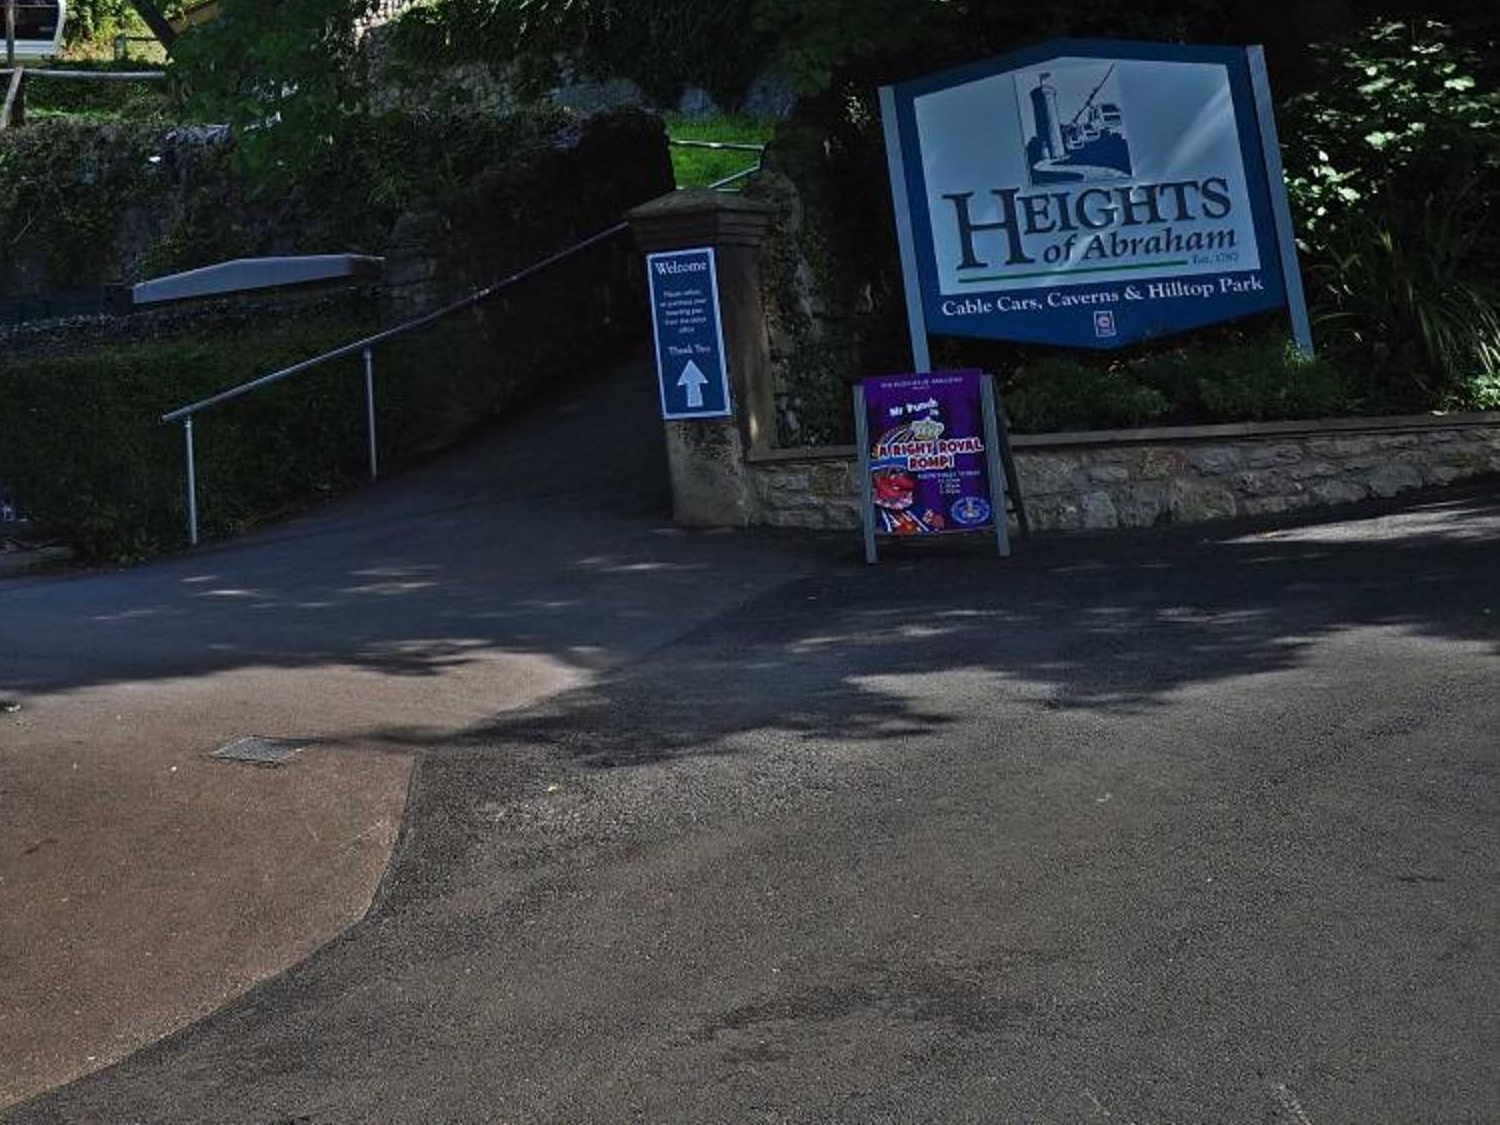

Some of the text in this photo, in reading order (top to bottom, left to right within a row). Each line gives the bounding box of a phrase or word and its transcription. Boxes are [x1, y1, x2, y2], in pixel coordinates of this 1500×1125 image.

[942, 177, 1231, 271] HEIGHTS
[1043, 226, 1237, 264] of Abraham
[655, 260, 708, 275] Welcome
[941, 274, 1265, 316] Cable Cars, Caverns & Hilltop Park
[890, 440, 934, 457] RIGHT
[938, 436, 984, 455] ROYAL
